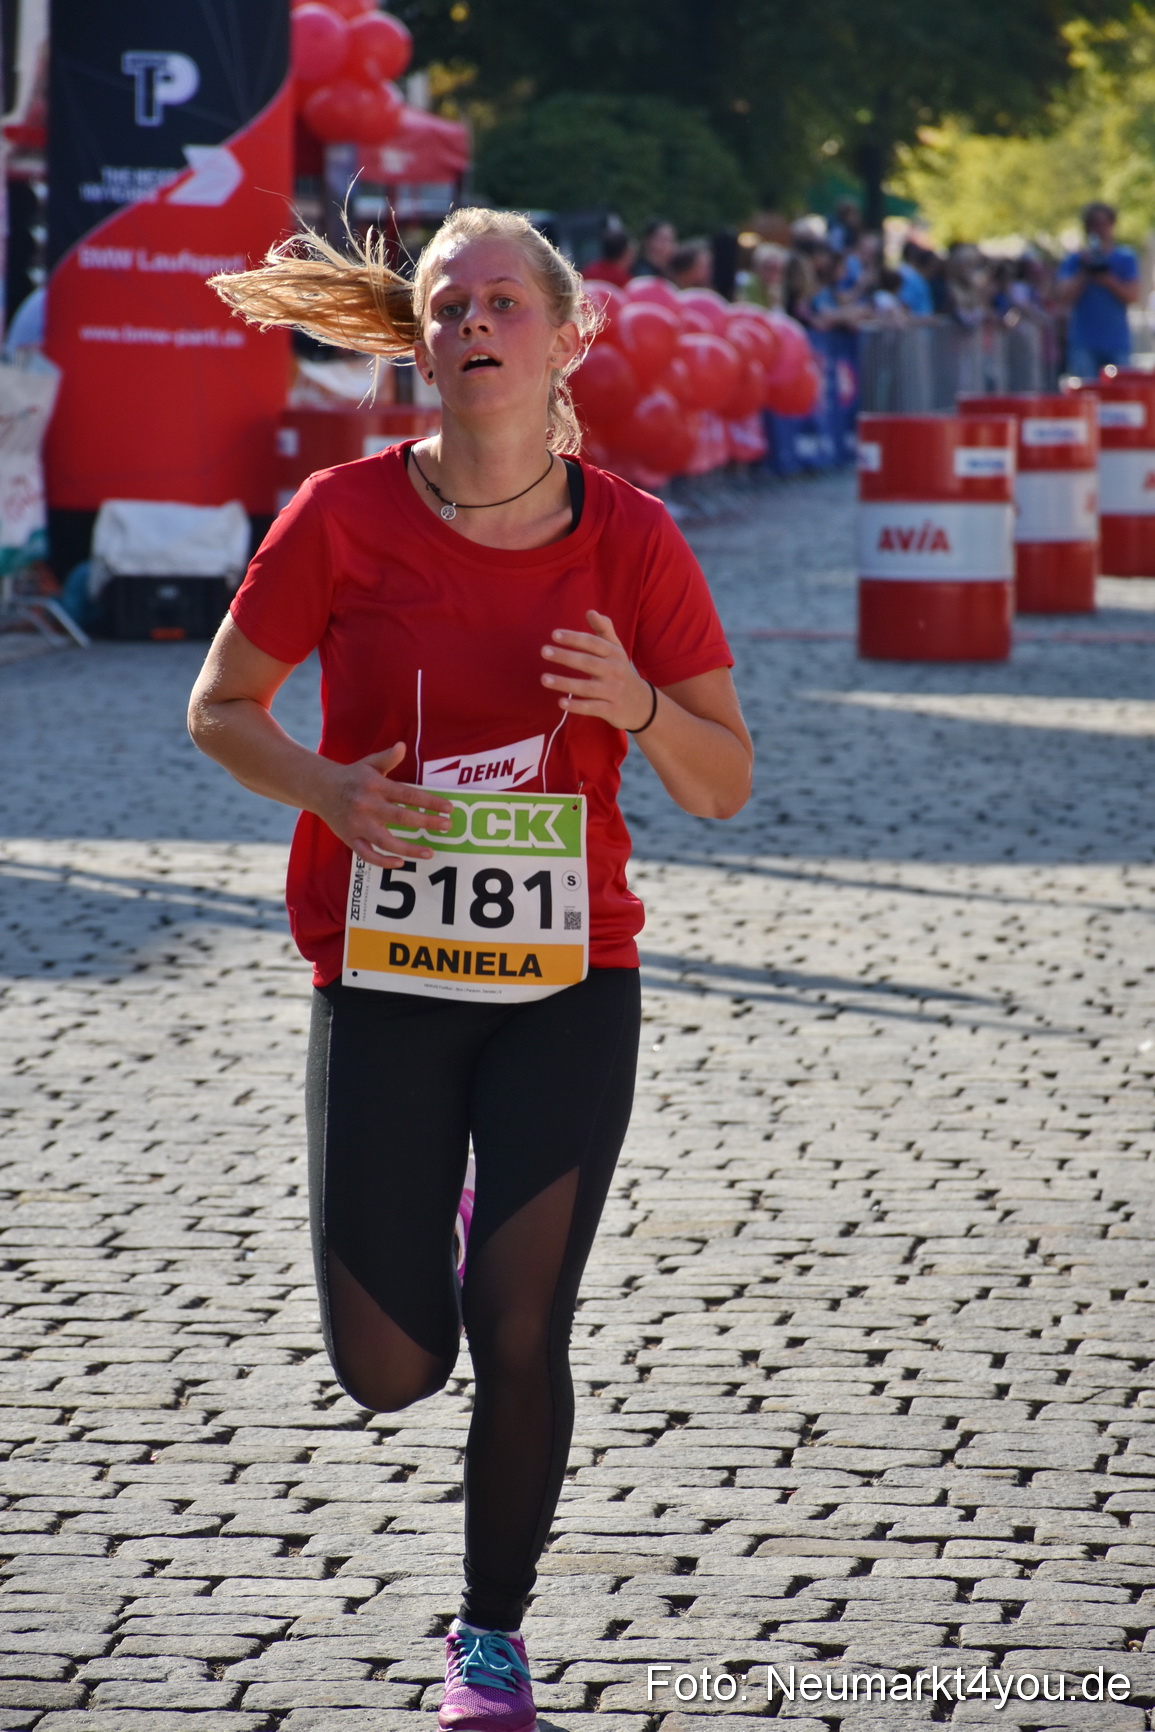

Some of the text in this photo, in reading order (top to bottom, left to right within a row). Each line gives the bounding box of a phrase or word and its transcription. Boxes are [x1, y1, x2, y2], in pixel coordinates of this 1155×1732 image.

[79, 246, 132, 269] BMW
[457, 757, 515, 785] DEHN
[567, 875, 576, 886] S
[375, 861, 552, 929] 5181
[388, 942, 543, 978] DANIELA
